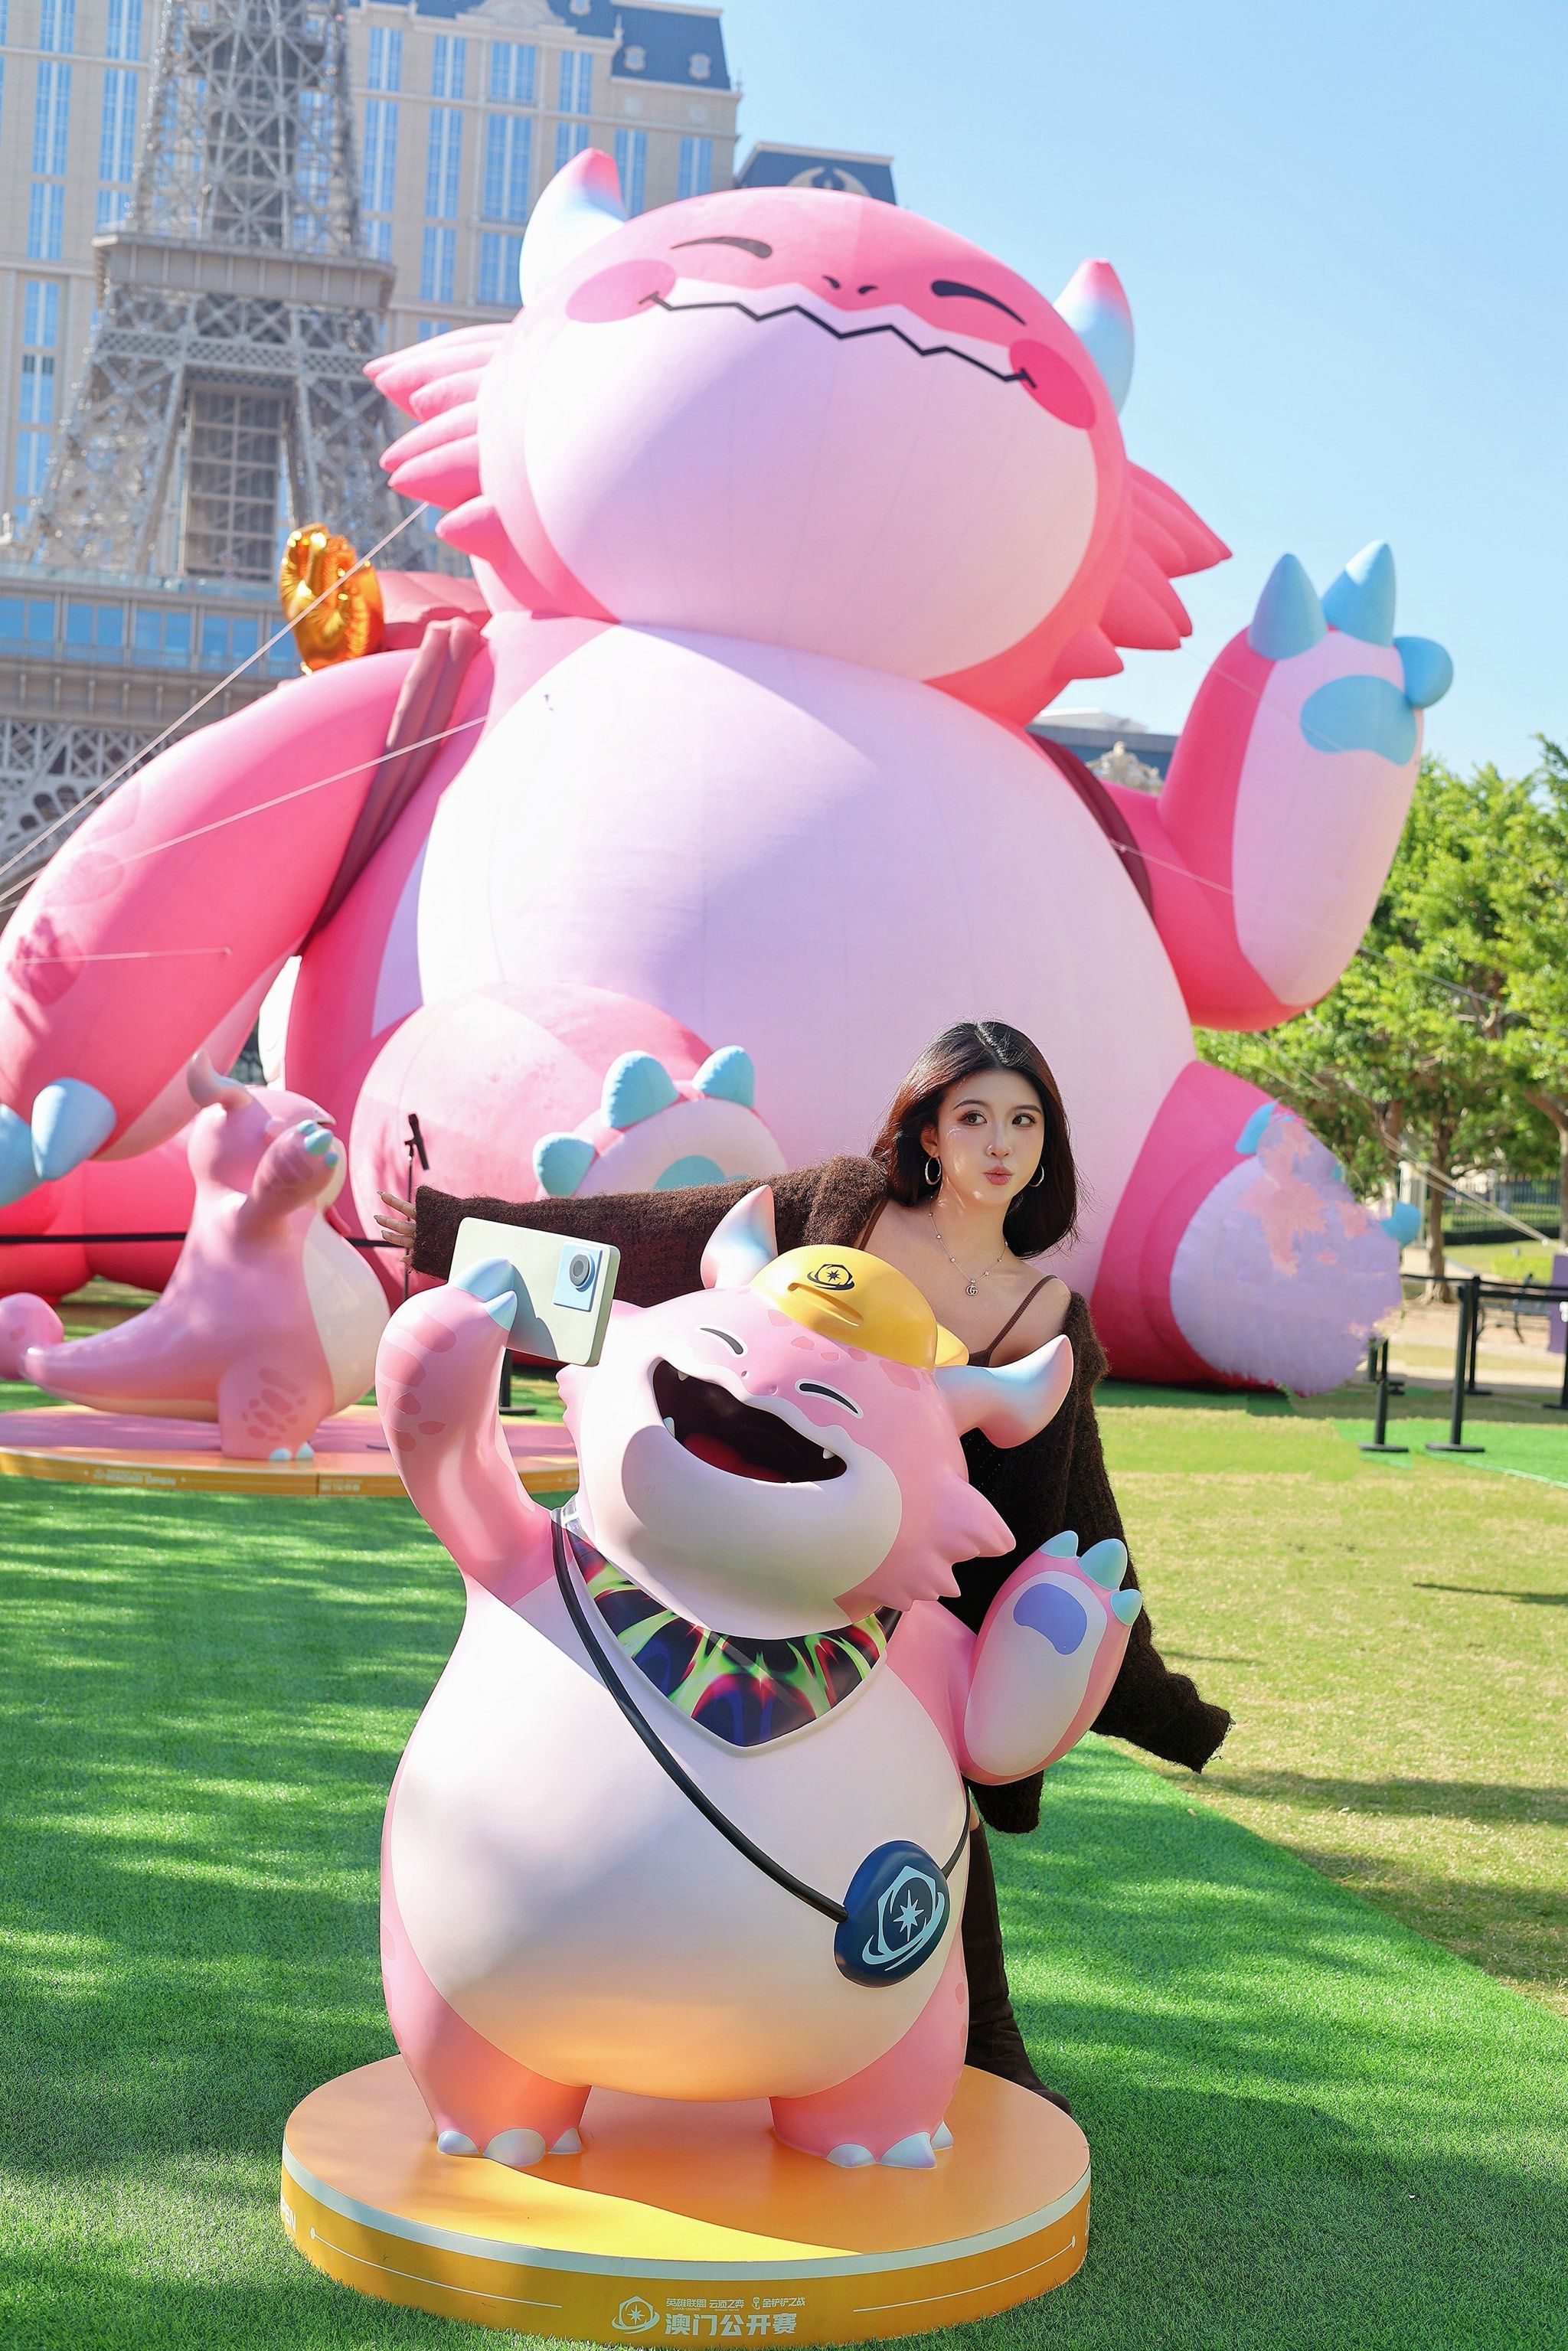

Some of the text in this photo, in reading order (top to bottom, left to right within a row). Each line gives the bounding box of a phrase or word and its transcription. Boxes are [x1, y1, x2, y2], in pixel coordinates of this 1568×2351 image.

[665, 2297, 805, 2309] 英雄联盟 云顶之弈 金铲铲之战
[665, 2313, 797, 2336] 澳门公开赛
